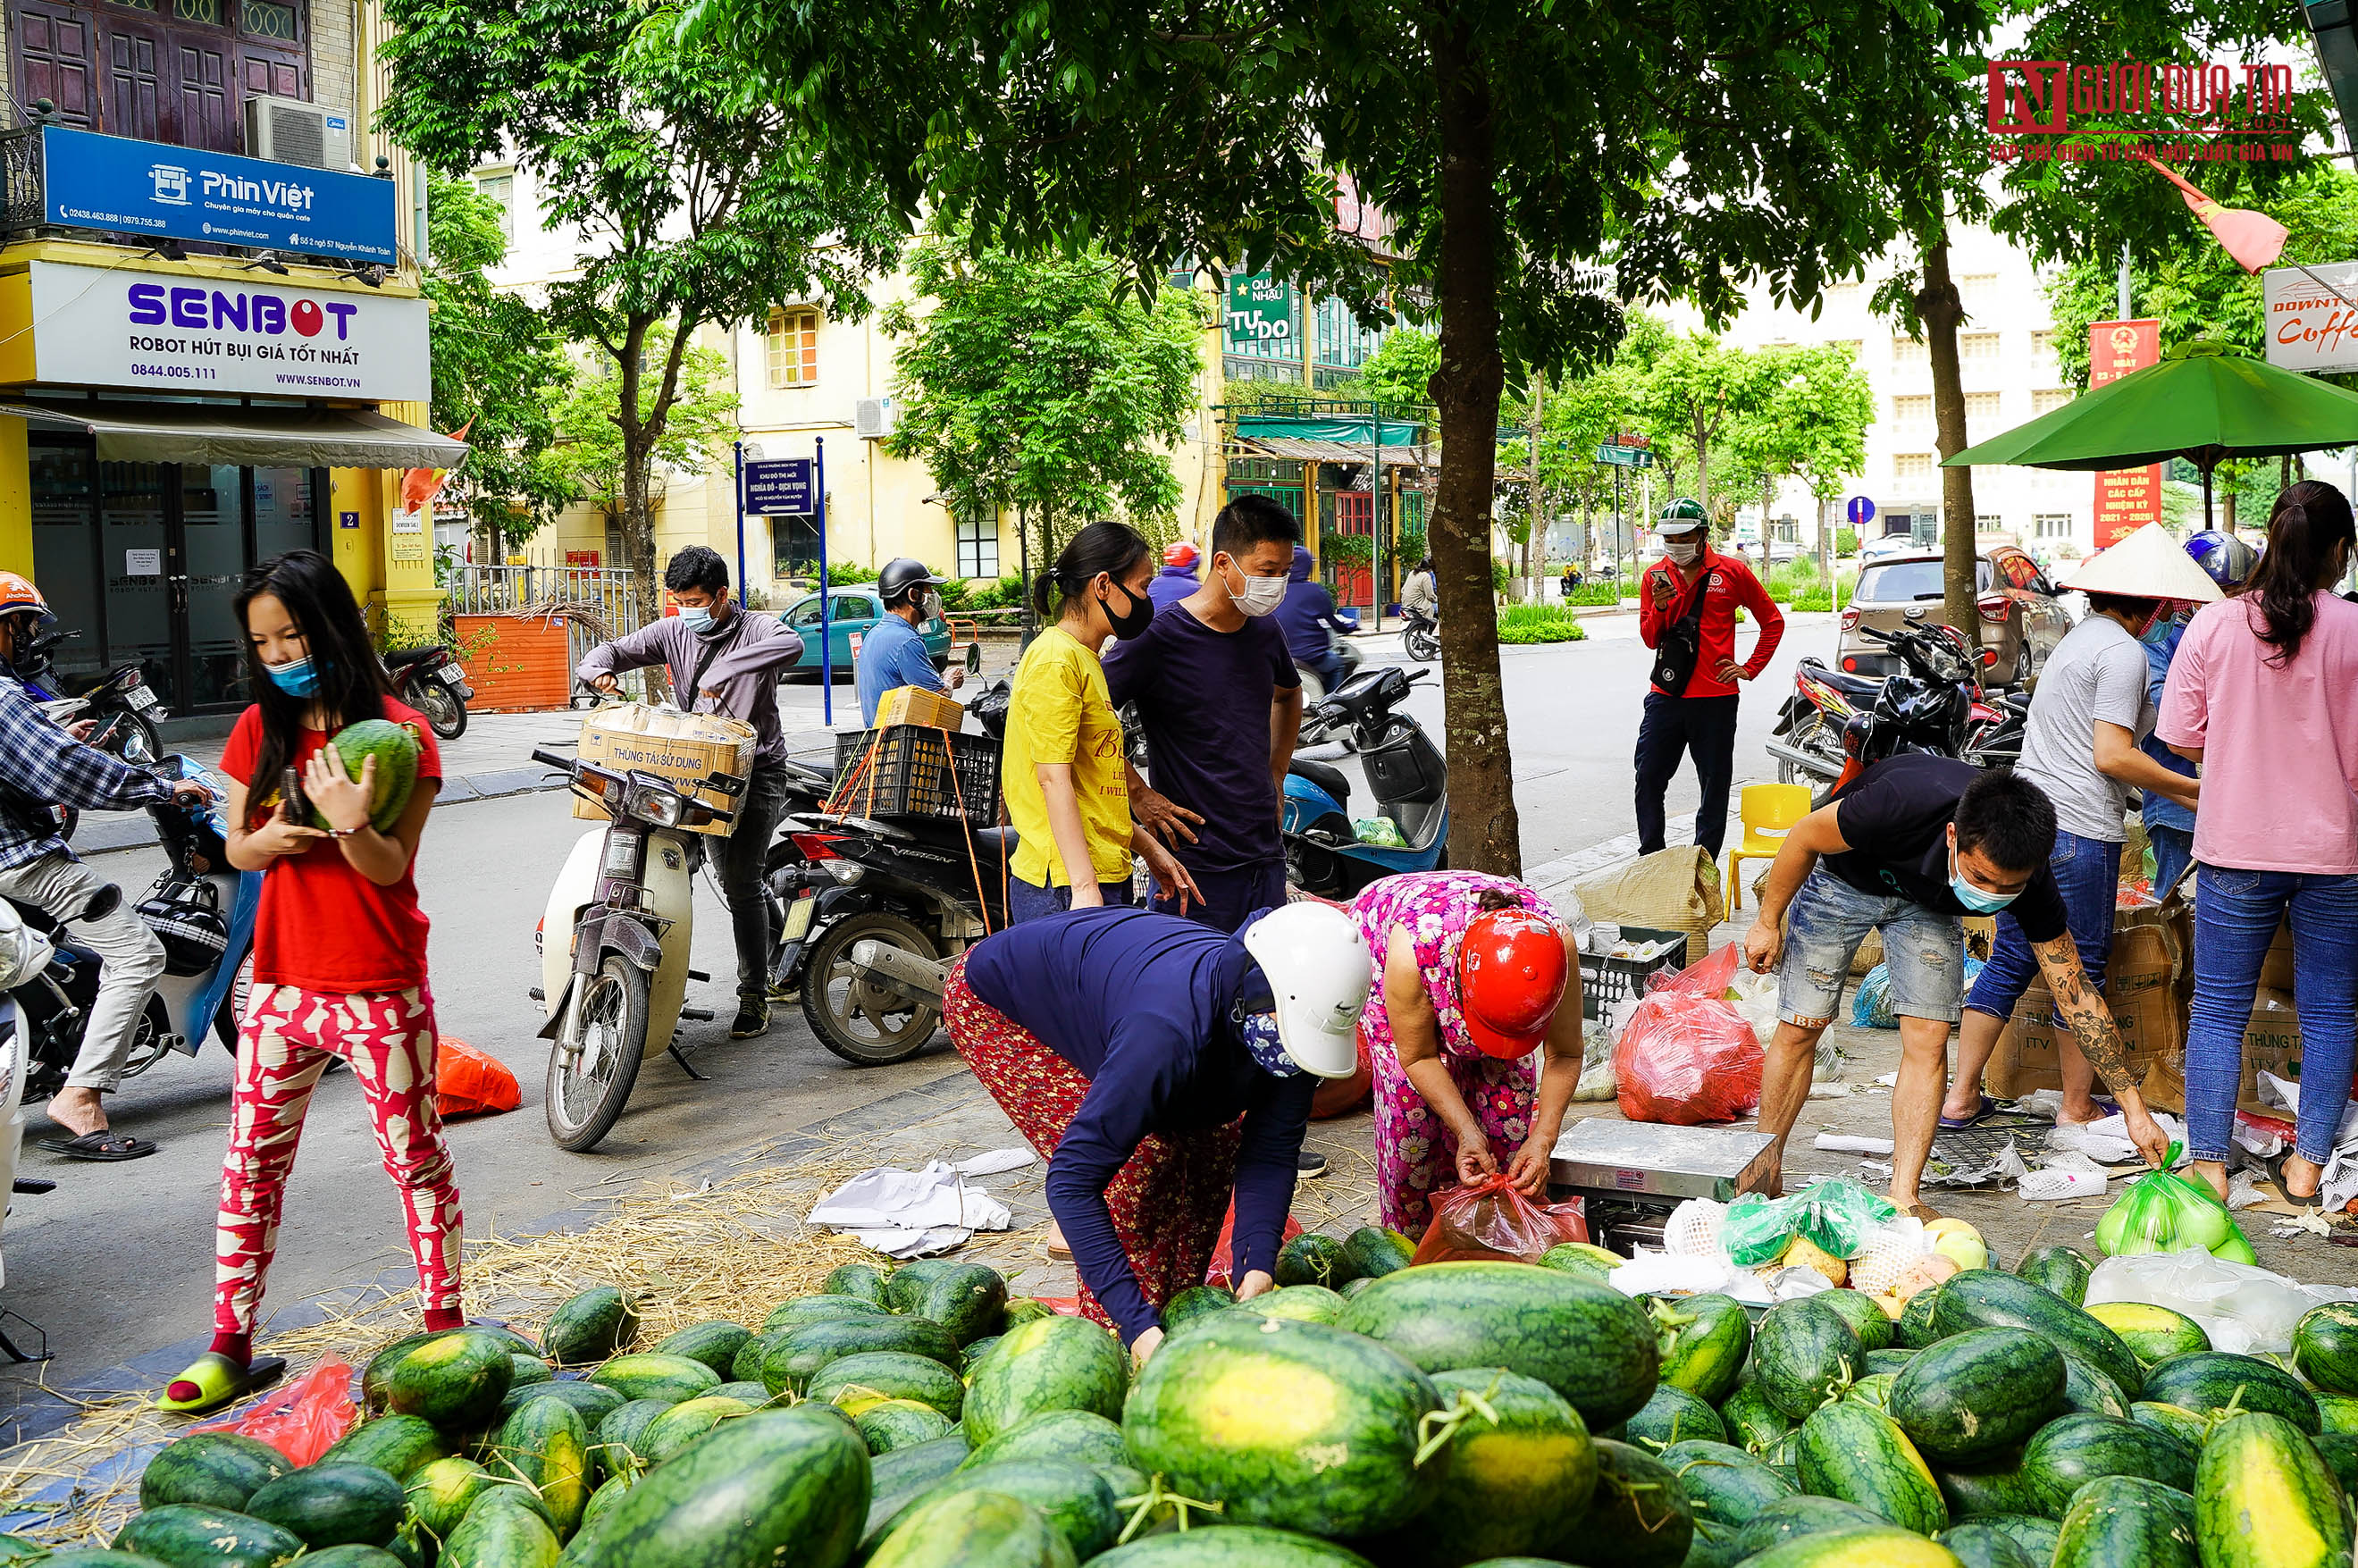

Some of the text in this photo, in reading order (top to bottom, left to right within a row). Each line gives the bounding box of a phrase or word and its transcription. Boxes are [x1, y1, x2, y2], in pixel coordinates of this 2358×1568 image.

[199, 171, 314, 212] Phin Việt
[69, 208, 166, 229] 02438.463.888 0979.755.388
[204, 201, 311, 222] Chuyên gia máy cho quán cafe
[212, 226, 269, 239] www.phinviet.com
[299, 234, 309, 245] Số
[309, 238, 314, 246] 2
[335, 240, 357, 253] Nguyễn
[357, 243, 377, 255] Khánh
[377, 247, 391, 256] Toàn
[128, 282, 358, 341] SENBOT
[1229, 309, 1289, 339] TỰ DO
[130, 335, 359, 365] ROBOT HÚT BỤI GIÁ TỐT NHẤT
[131, 364, 361, 388] 0844.005.111 WWW.SENBOT.VN
[2103, 475, 2150, 486] NHÂN DÂN
[2107, 486, 2146, 498] CÁC CẤP
[347, 514, 354, 526] 2
[614, 747, 643, 762] THÙNG
[676, 757, 702, 771] DỤNG
[2026, 1037, 2050, 1050] ITV
[2247, 1029, 2289, 1049] THÙNG
